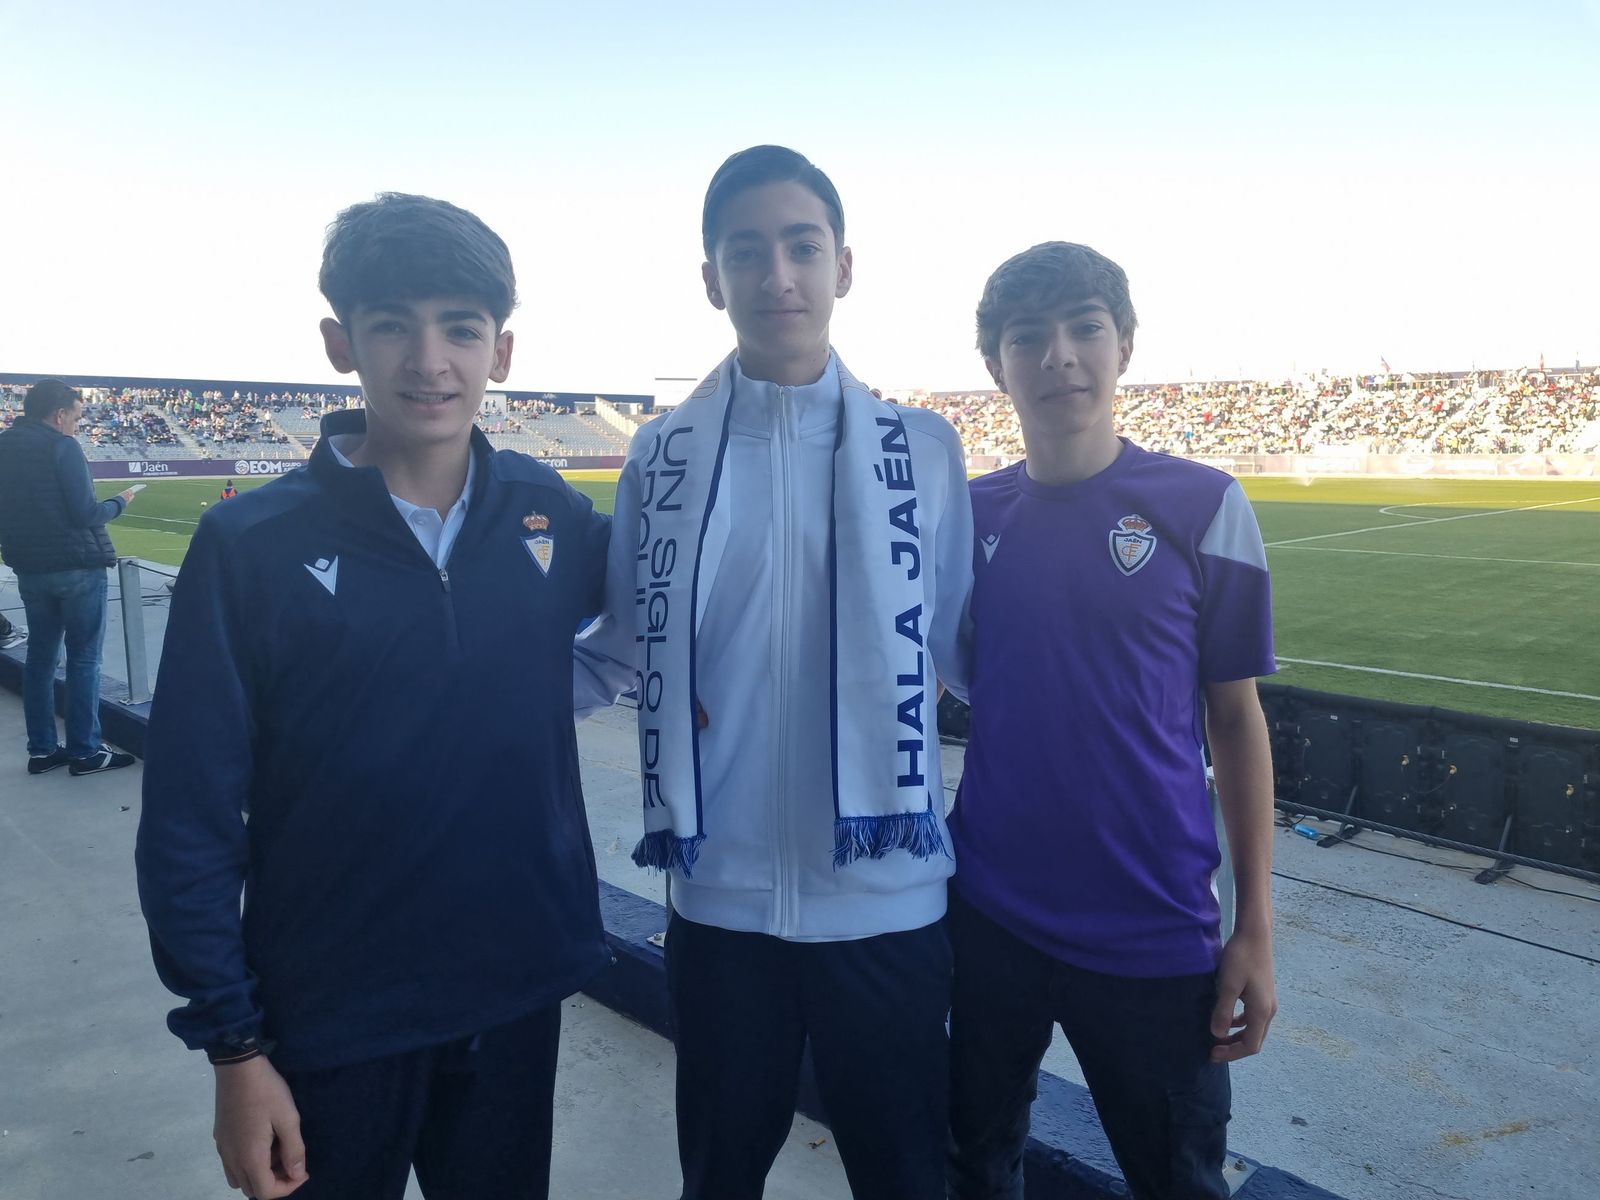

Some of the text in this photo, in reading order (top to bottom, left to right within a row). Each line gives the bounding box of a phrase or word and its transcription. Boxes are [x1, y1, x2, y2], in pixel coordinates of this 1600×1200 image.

[141, 461, 169, 473] Jaén
[249, 460, 282, 474] EOM
[655, 426, 694, 512] UN
[646, 537, 677, 713] SIGLO
[873, 417, 925, 788] HALA JAÉN
[643, 728, 666, 809] DE
